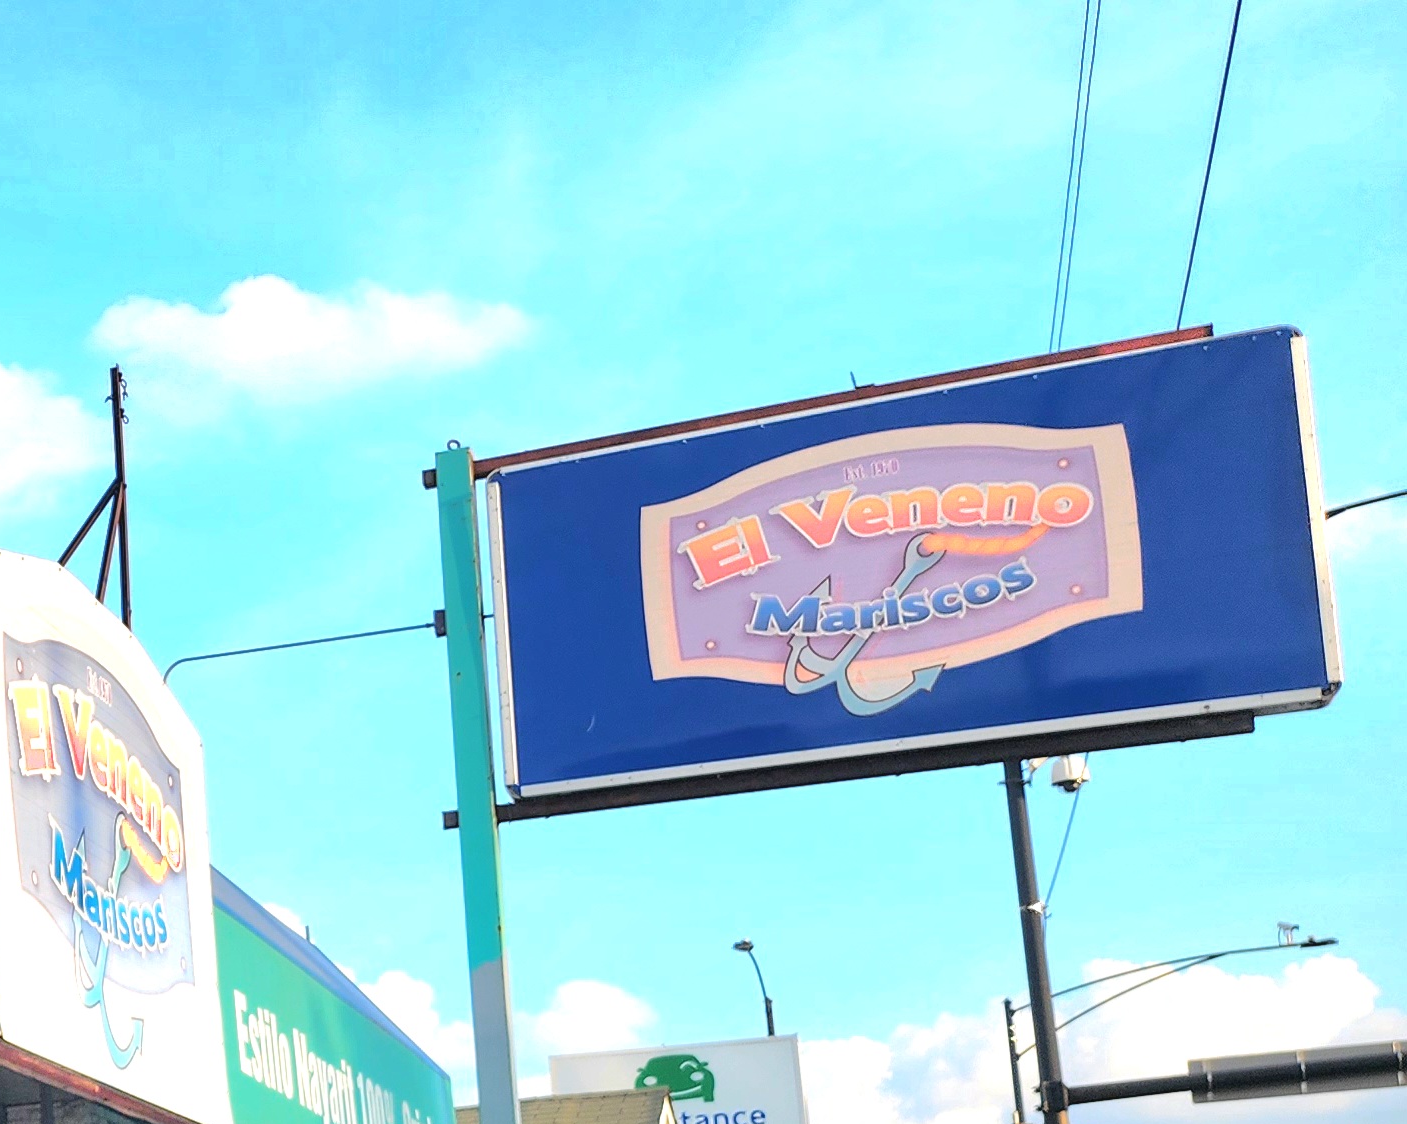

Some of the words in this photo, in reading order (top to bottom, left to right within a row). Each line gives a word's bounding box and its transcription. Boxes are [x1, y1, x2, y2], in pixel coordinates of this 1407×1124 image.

[677, 512, 781, 591] El
[771, 477, 1096, 549] Veneno
[744, 558, 1039, 639] Mariscos
[8, 675, 62, 782] El
[52, 683, 184, 873] Veneno
[48, 813, 169, 956] Mariscos
[233, 988, 295, 1100] Estilo
